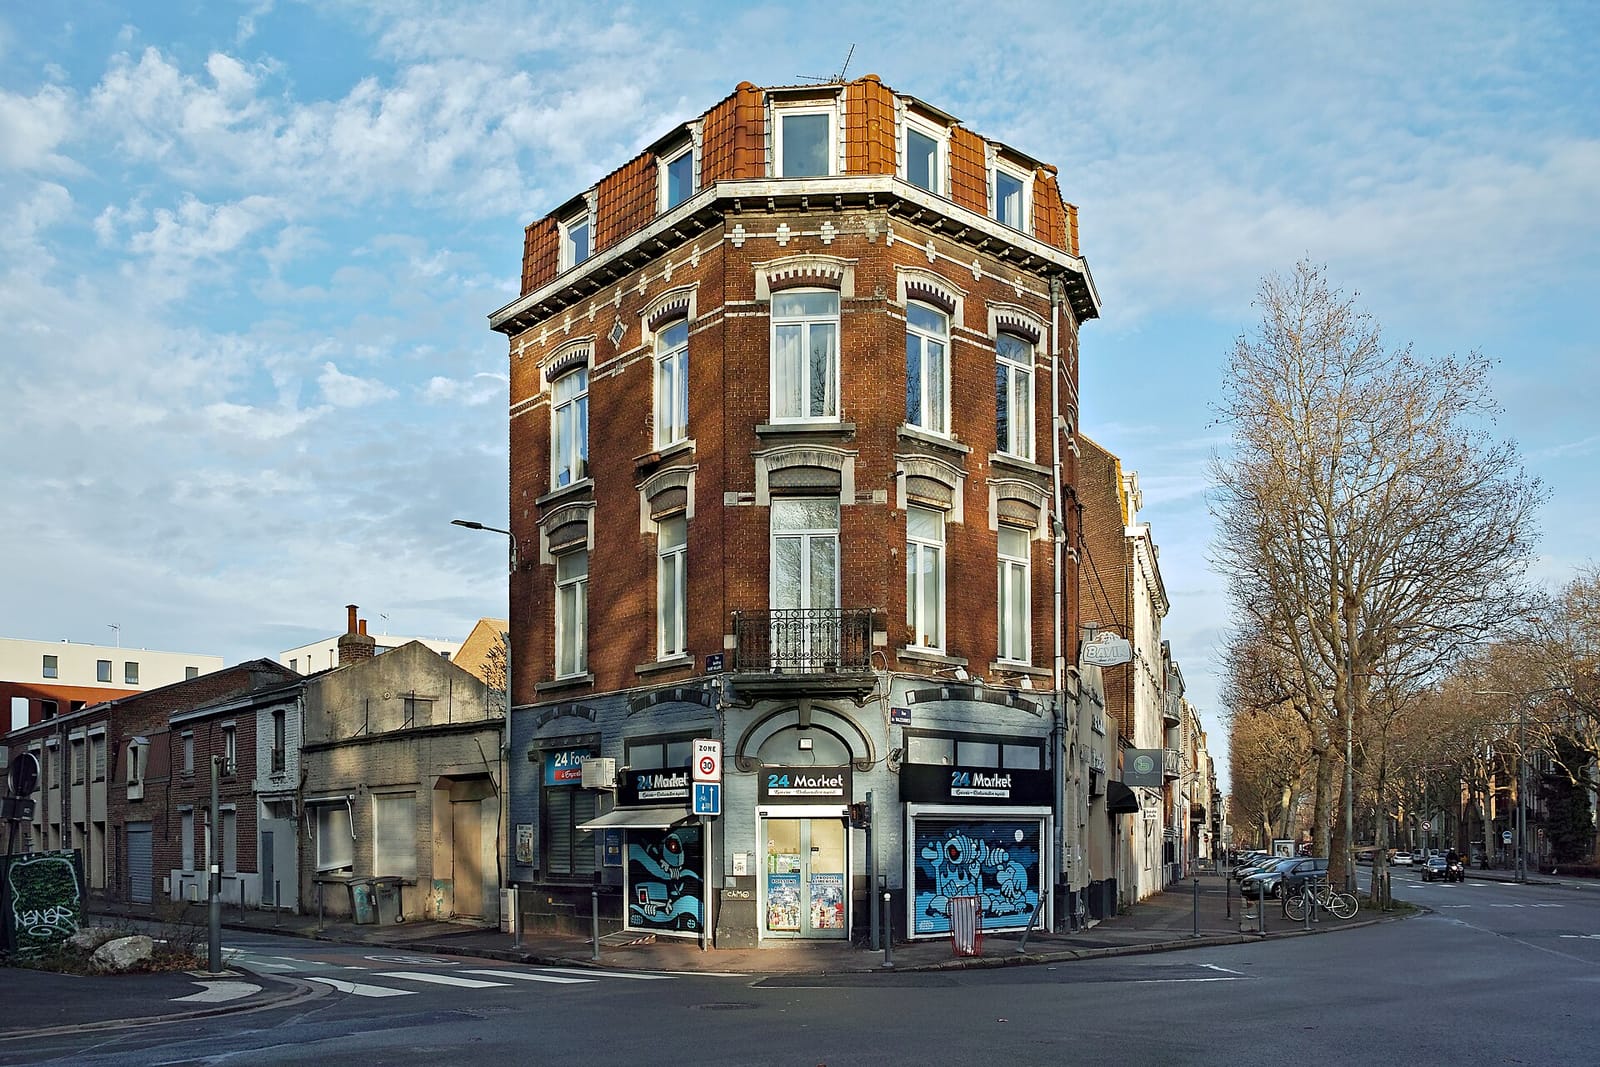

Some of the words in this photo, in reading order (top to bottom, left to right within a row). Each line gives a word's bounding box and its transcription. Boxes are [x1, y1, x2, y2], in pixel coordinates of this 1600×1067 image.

[1086, 645, 1129, 659] BAVIK
[698, 745, 717, 753] ZONE
[554, 752, 568, 767] 24
[702, 761, 713, 770] 30
[637, 775, 653, 789] 24
[654, 772, 689, 788] Market
[767, 774, 790, 787] 24
[793, 774, 843, 787] Market
[951, 771, 970, 787] 24
[972, 772, 1012, 788] Market
